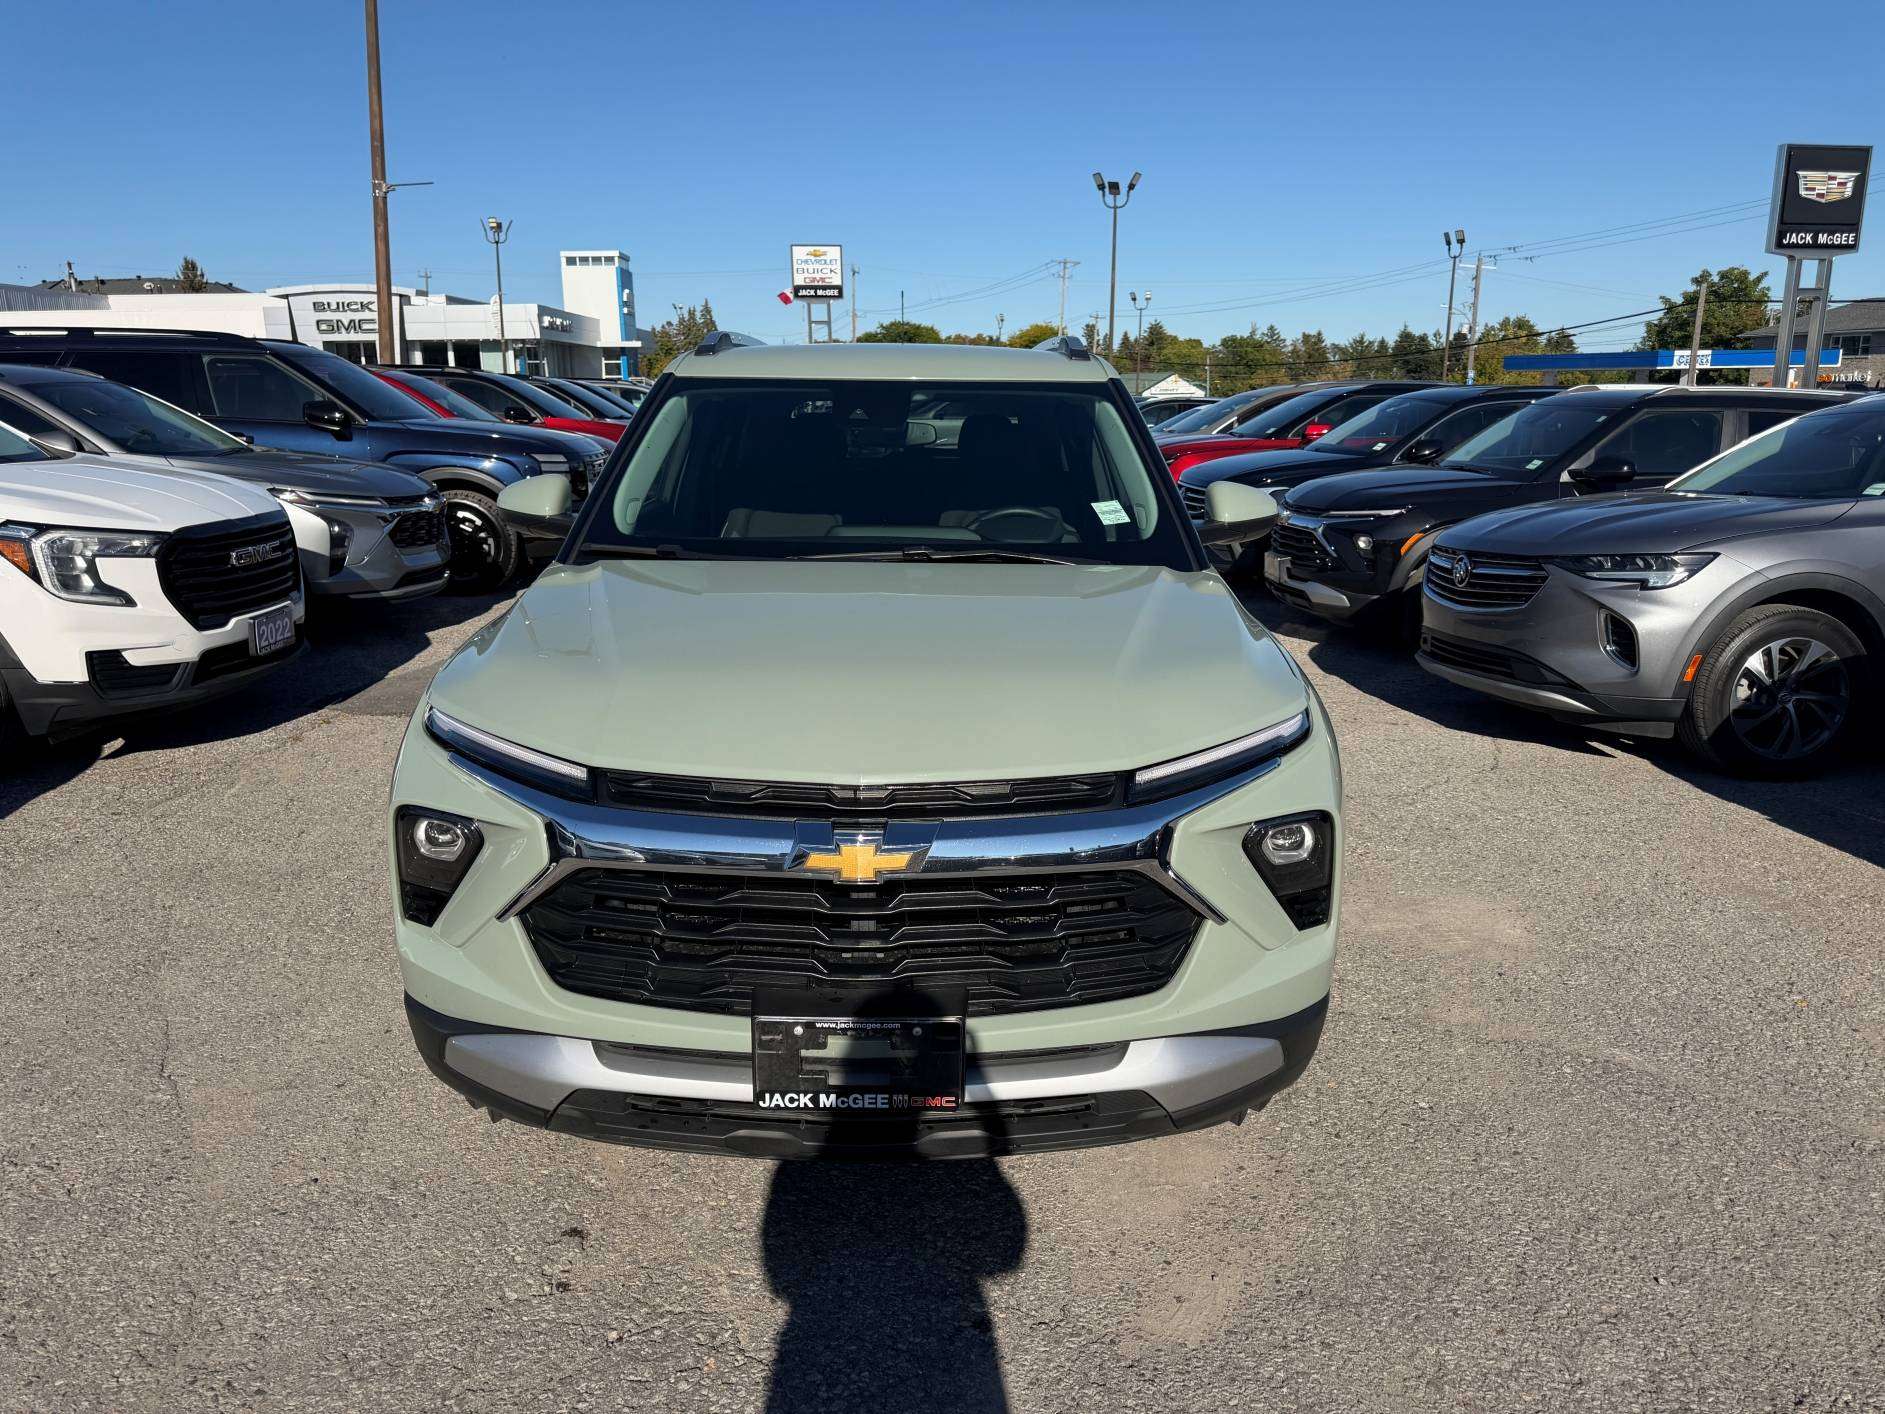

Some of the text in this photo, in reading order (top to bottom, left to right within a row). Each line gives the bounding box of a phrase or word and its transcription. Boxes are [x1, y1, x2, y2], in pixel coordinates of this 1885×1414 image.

[1782, 233, 1856, 245] JACK McGEE
[796, 258, 839, 266] CHEVROLET
[796, 267, 839, 275] BUICK
[803, 276, 833, 284] GMC
[798, 289, 839, 297] JACK McGEE
[312, 301, 377, 313] BUICK
[315, 318, 379, 335] GMC
[232, 540, 282, 567] GMC
[260, 617, 291, 648] 2022
[815, 1020, 901, 1030] www.jackmcgee.com
[758, 1093, 956, 1109] JACK McGEE GMC
